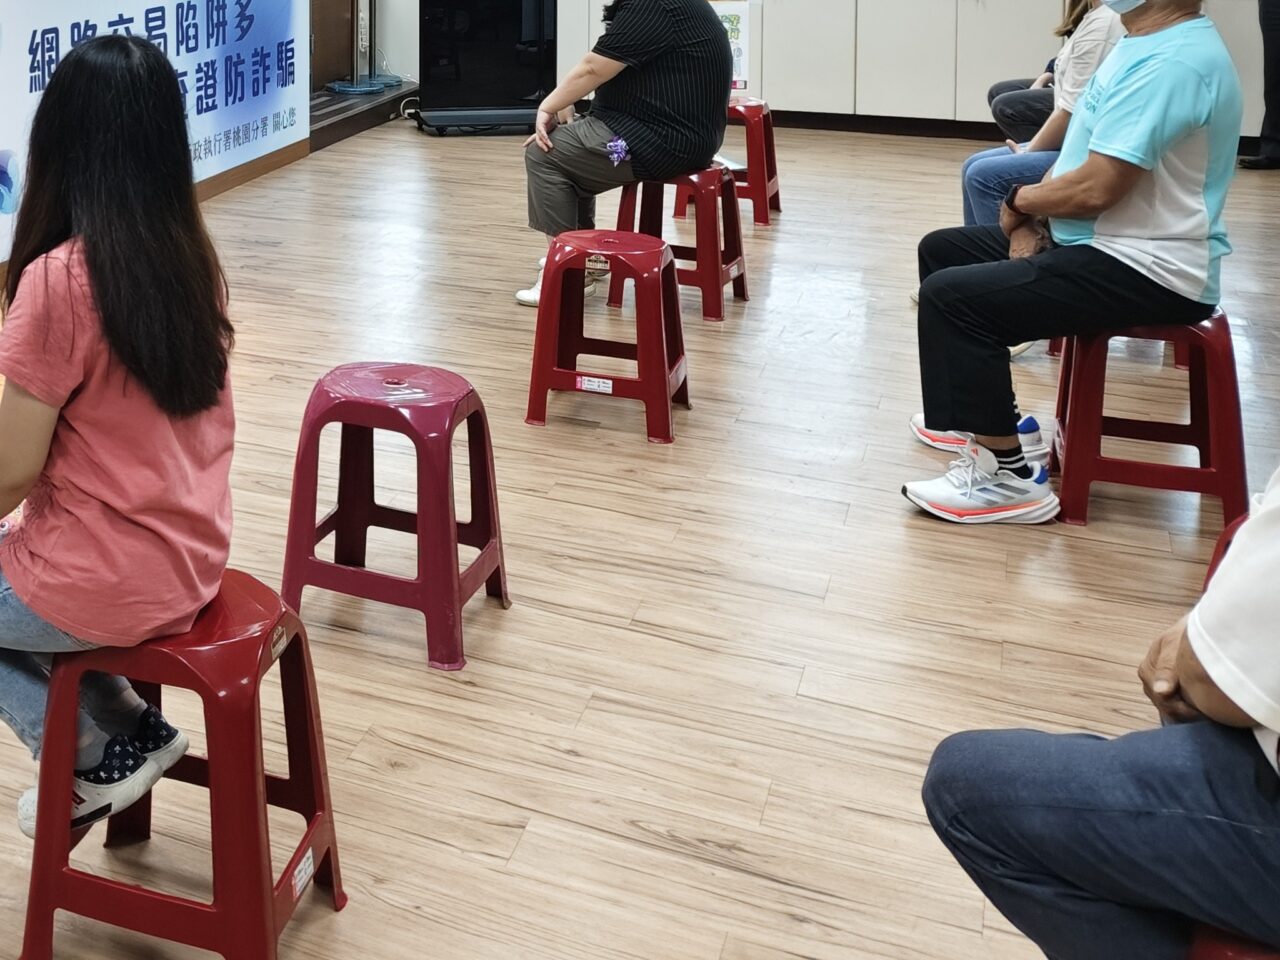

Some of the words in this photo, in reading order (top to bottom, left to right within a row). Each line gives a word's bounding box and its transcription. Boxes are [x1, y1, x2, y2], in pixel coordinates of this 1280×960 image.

[189, 115, 269, 161] 政執行署桃園分署
[272, 107, 297, 134] 關心您
